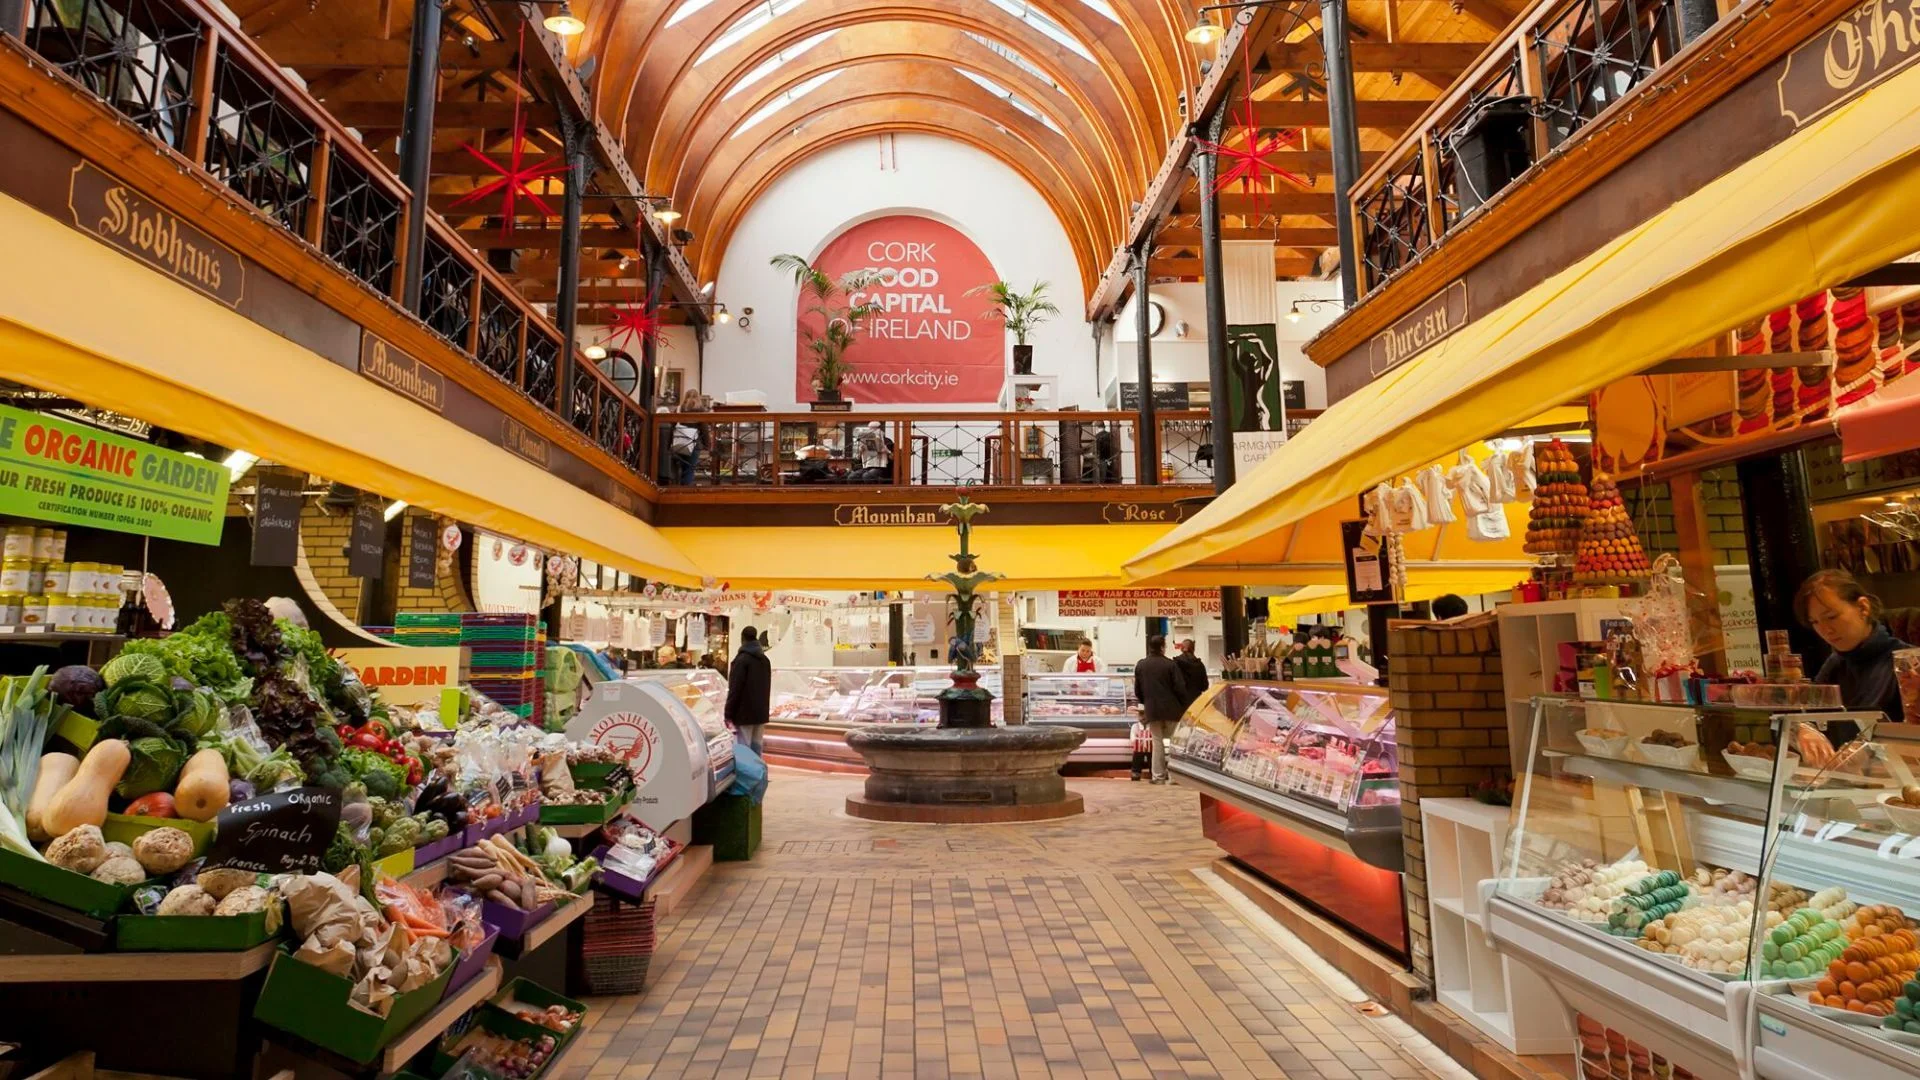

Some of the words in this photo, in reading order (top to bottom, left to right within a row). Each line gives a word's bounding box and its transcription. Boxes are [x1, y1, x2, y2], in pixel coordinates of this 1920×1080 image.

[868, 242, 936, 262] CORK
[850, 293, 952, 314] CAPITAL
[870, 318, 971, 340] IRELAND
[1383, 306, 1448, 365] Durcan
[369, 340, 437, 404] Moynihan
[842, 369, 959, 390] www.corkcity.ie
[0, 417, 17, 450] E
[25, 425, 137, 477] ORGANIC
[141, 454, 219, 496] GARDEN
[0, 469, 19, 488] UR
[25, 475, 66, 496] FRESH
[69, 484, 123, 507] PRODUCE
[125, 495, 136, 509] IS
[140, 498, 168, 515] 100%
[171, 504, 212, 523] ORGANIC
[38, 501, 87, 519] CERTIFICATION
[88, 509, 115, 522] NUMBER
[850, 506, 936, 524] Moynihan
[1118, 503, 1166, 521] Rose
[787, 594, 829, 606] OULTRY
[1059, 599, 1104, 607] SAUSAGES
[1103, 590, 1123, 598] HAM
[1133, 590, 1165, 598] BACON
[1115, 599, 1138, 607] LOIN
[1059, 608, 1096, 616] PUDDING
[1115, 608, 1137, 616] HAM
[1734, 657, 1759, 667] made
[351, 666, 447, 686] ARDEN
[590, 713, 660, 744] MOYNIHANS
[238, 821, 312, 847] Spinach
